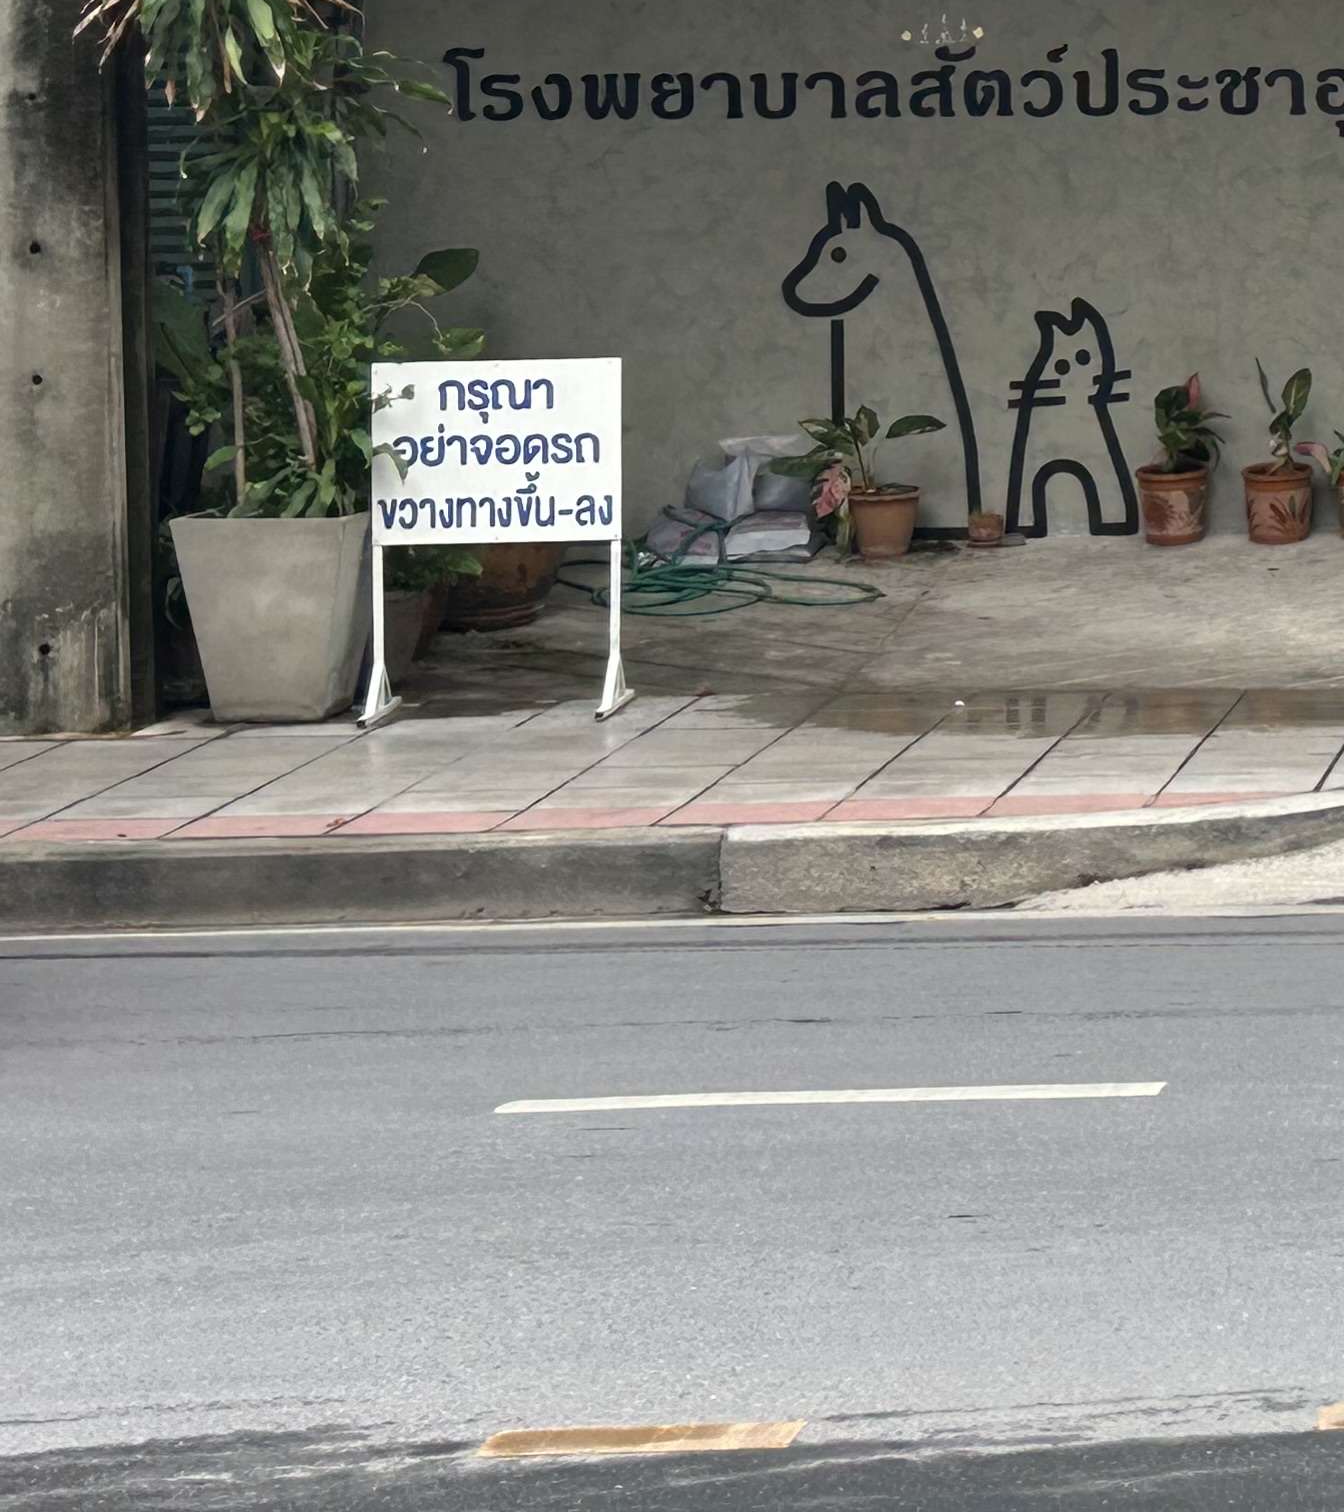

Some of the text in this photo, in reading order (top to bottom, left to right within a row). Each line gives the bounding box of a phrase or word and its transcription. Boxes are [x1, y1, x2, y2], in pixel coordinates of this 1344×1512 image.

[437, 377, 555, 424] กรุณา
[392, 423, 600, 467] อย่าจอดรถ
[377, 471, 614, 530] ขวางทางขึ้น-ลง
